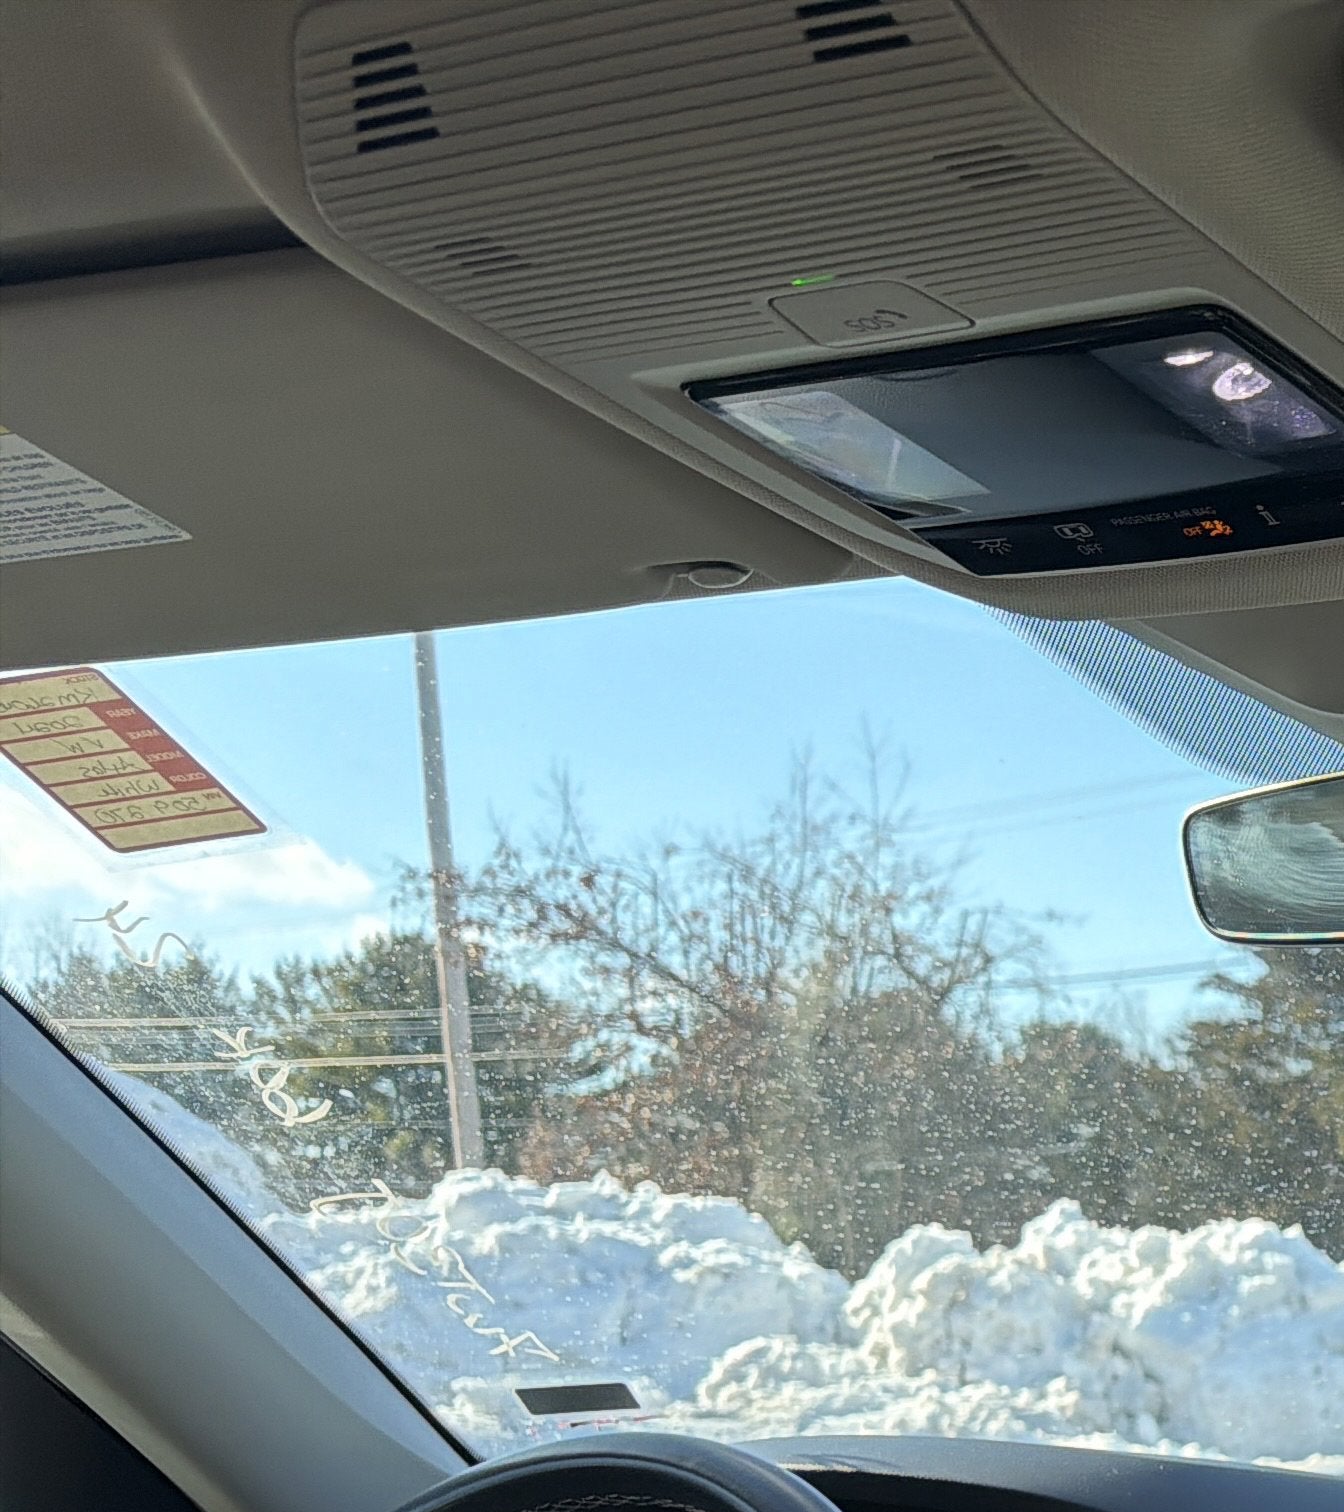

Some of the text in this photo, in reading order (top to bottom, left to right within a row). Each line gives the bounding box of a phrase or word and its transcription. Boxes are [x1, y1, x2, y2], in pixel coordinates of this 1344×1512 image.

[844, 314, 895, 333] SOS
[1183, 526, 1203, 538] OFF
[1076, 543, 1103, 556] OFF
